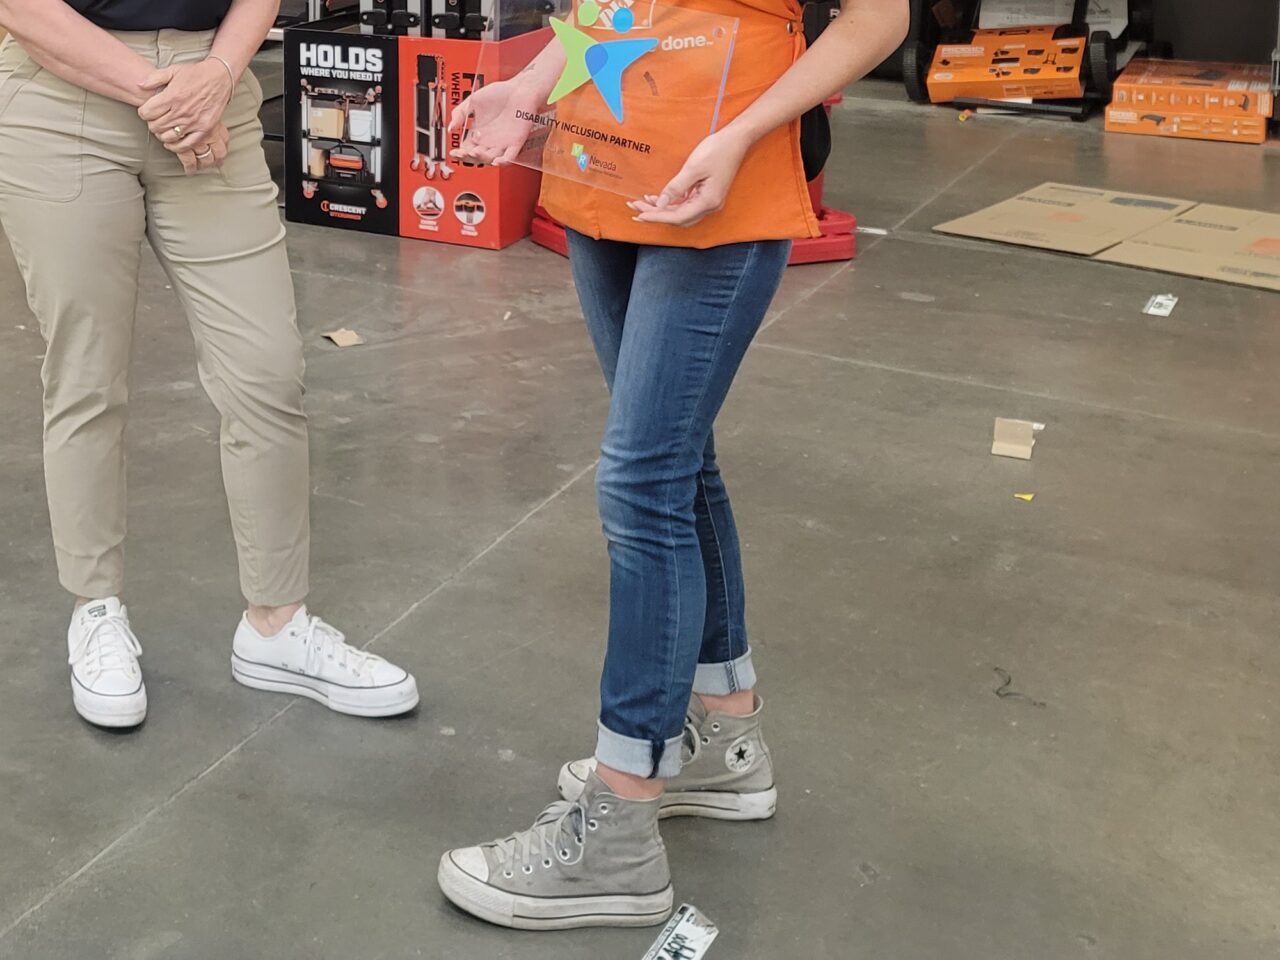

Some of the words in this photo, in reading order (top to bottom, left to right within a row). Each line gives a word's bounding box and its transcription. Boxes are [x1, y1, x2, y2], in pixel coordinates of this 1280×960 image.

[299, 42, 384, 72] HOLDS
[300, 66, 330, 78] WHERE
[332, 69, 349, 80] YOU
[350, 70, 373, 82] NEED
[374, 72, 383, 83] IT
[451, 72, 460, 106] WHEN
[515, 109, 561, 129] DISABILITY
[561, 121, 609, 143] INCLUSION
[609, 135, 652, 155] PARTNER
[590, 155, 617, 172] Nevada
